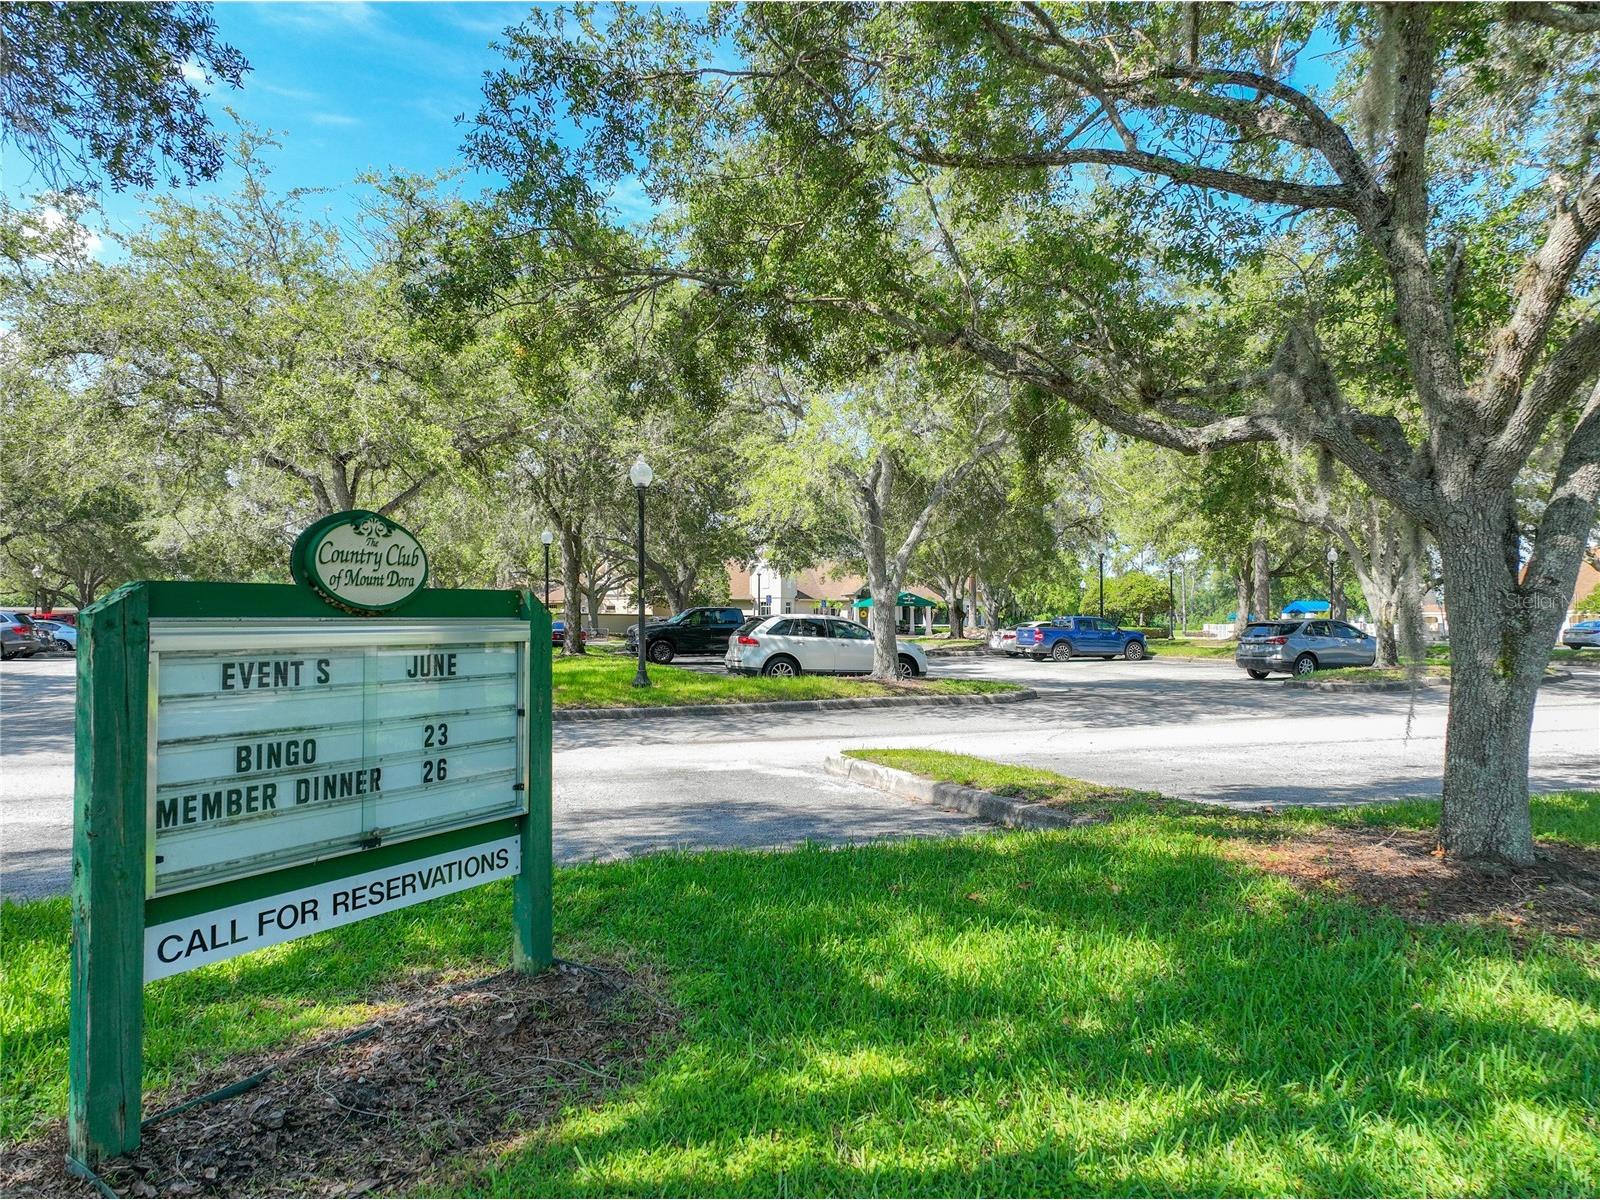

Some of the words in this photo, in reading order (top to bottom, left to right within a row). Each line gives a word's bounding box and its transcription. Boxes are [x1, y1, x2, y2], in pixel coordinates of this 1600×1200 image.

[318, 541, 383, 571] Country
[386, 544, 419, 566] Club
[366, 537, 379, 547] The
[329, 569, 344, 591] of
[344, 568, 384, 587] Mount
[387, 570, 415, 587] Dora
[407, 653, 457, 679] JUNE
[236, 739, 317, 773] BINGO
[424, 723, 448, 748] 23
[156, 783, 277, 829] MEMBER
[296, 767, 382, 805] DINNER
[423, 758, 447, 783] 26
[157, 920, 249, 963] CALL
[257, 899, 319, 937] FOR
[332, 848, 509, 917] RESERVATIONS
